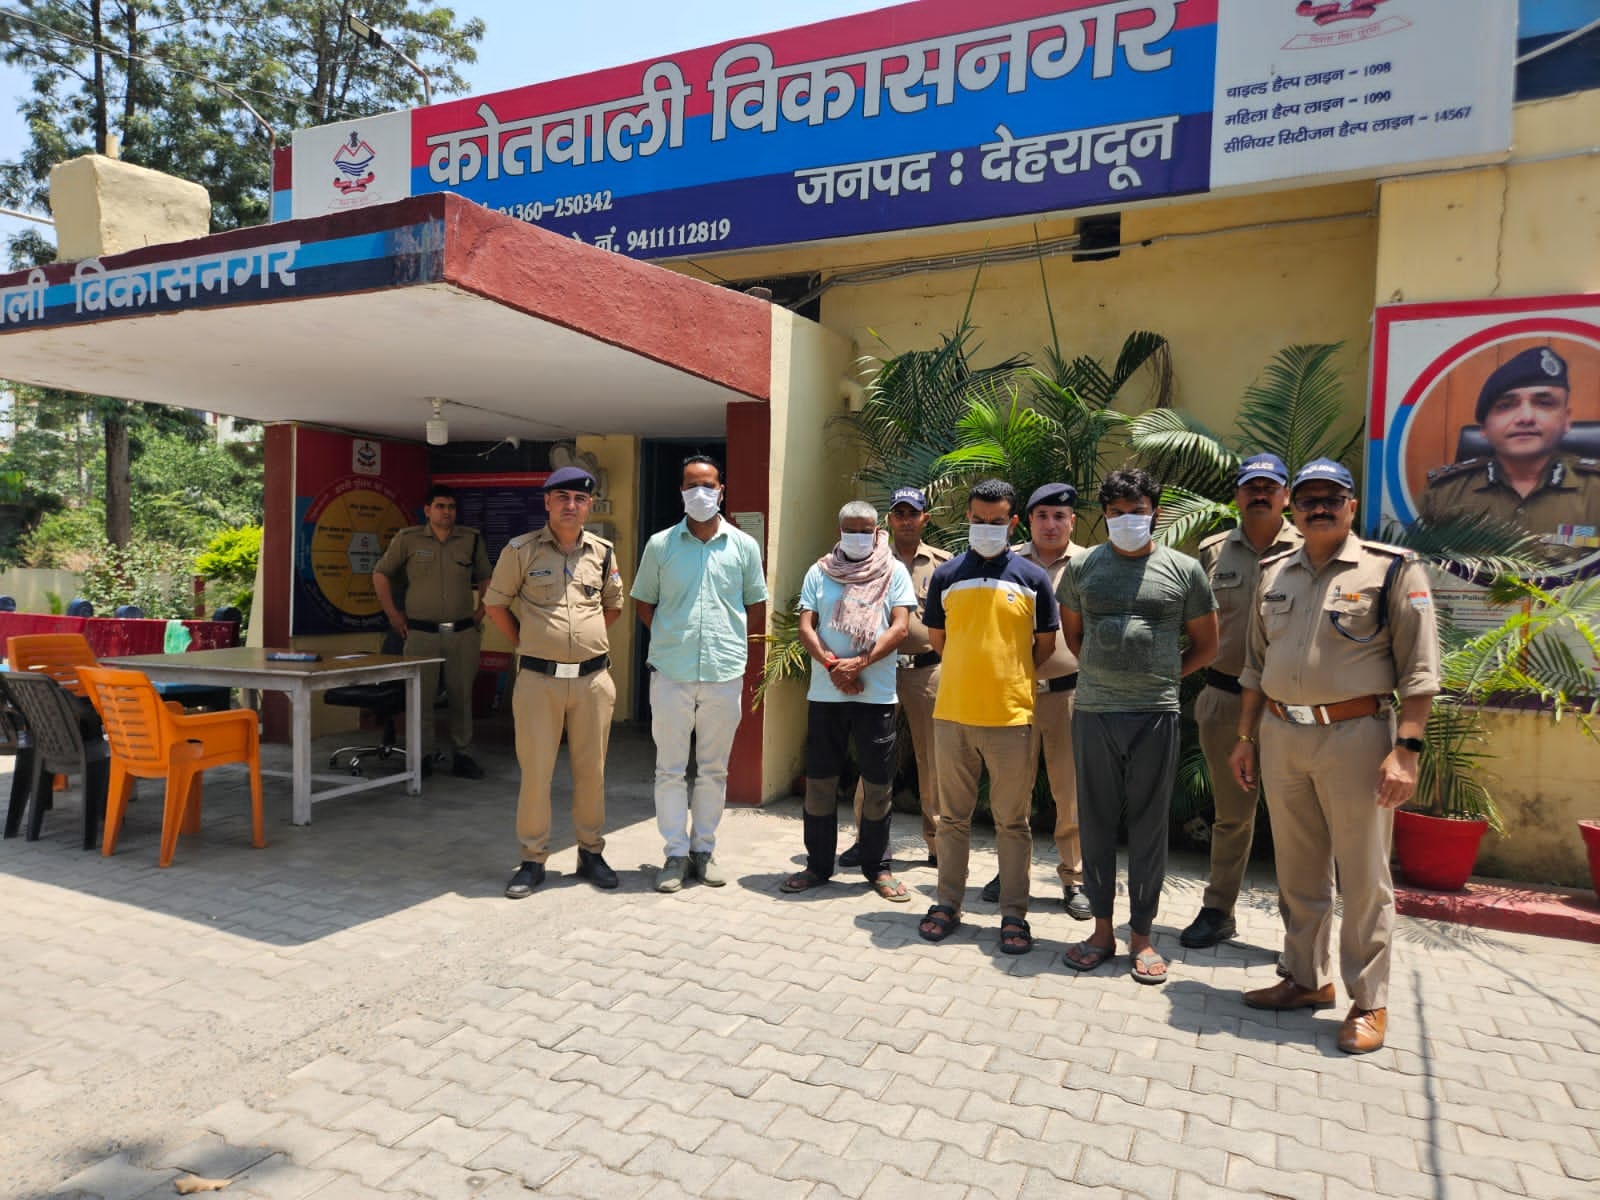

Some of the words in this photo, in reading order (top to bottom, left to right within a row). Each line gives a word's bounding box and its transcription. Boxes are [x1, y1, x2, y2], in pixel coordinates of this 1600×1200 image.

[426, 60, 692, 188] कोतवाली
[707, 0, 1183, 142] विकासनगर
[1271, 75, 1301, 93] हैल्प
[1303, 68, 1344, 87] लाइन
[1363, 62, 1392, 77] 1098
[1223, 136, 1275, 154] सीनियर
[1277, 126, 1335, 147] सिटीजन
[1338, 119, 1369, 138] हैल्प
[1372, 114, 1415, 132] लाइन
[1434, 105, 1473, 124] 14567
[1224, 108, 1268, 127] महिला
[1271, 103, 1301, 120] हैल्प
[1303, 95, 1344, 115] लाइन
[1363, 90, 1392, 105] 1090
[794, 150, 937, 205] जनपद
[980, 112, 1180, 190] देहरादून
[626, 218, 731, 252] 9411112819
[70, 240, 301, 314] विकासनगर
[894, 490, 920, 501] POLICE
